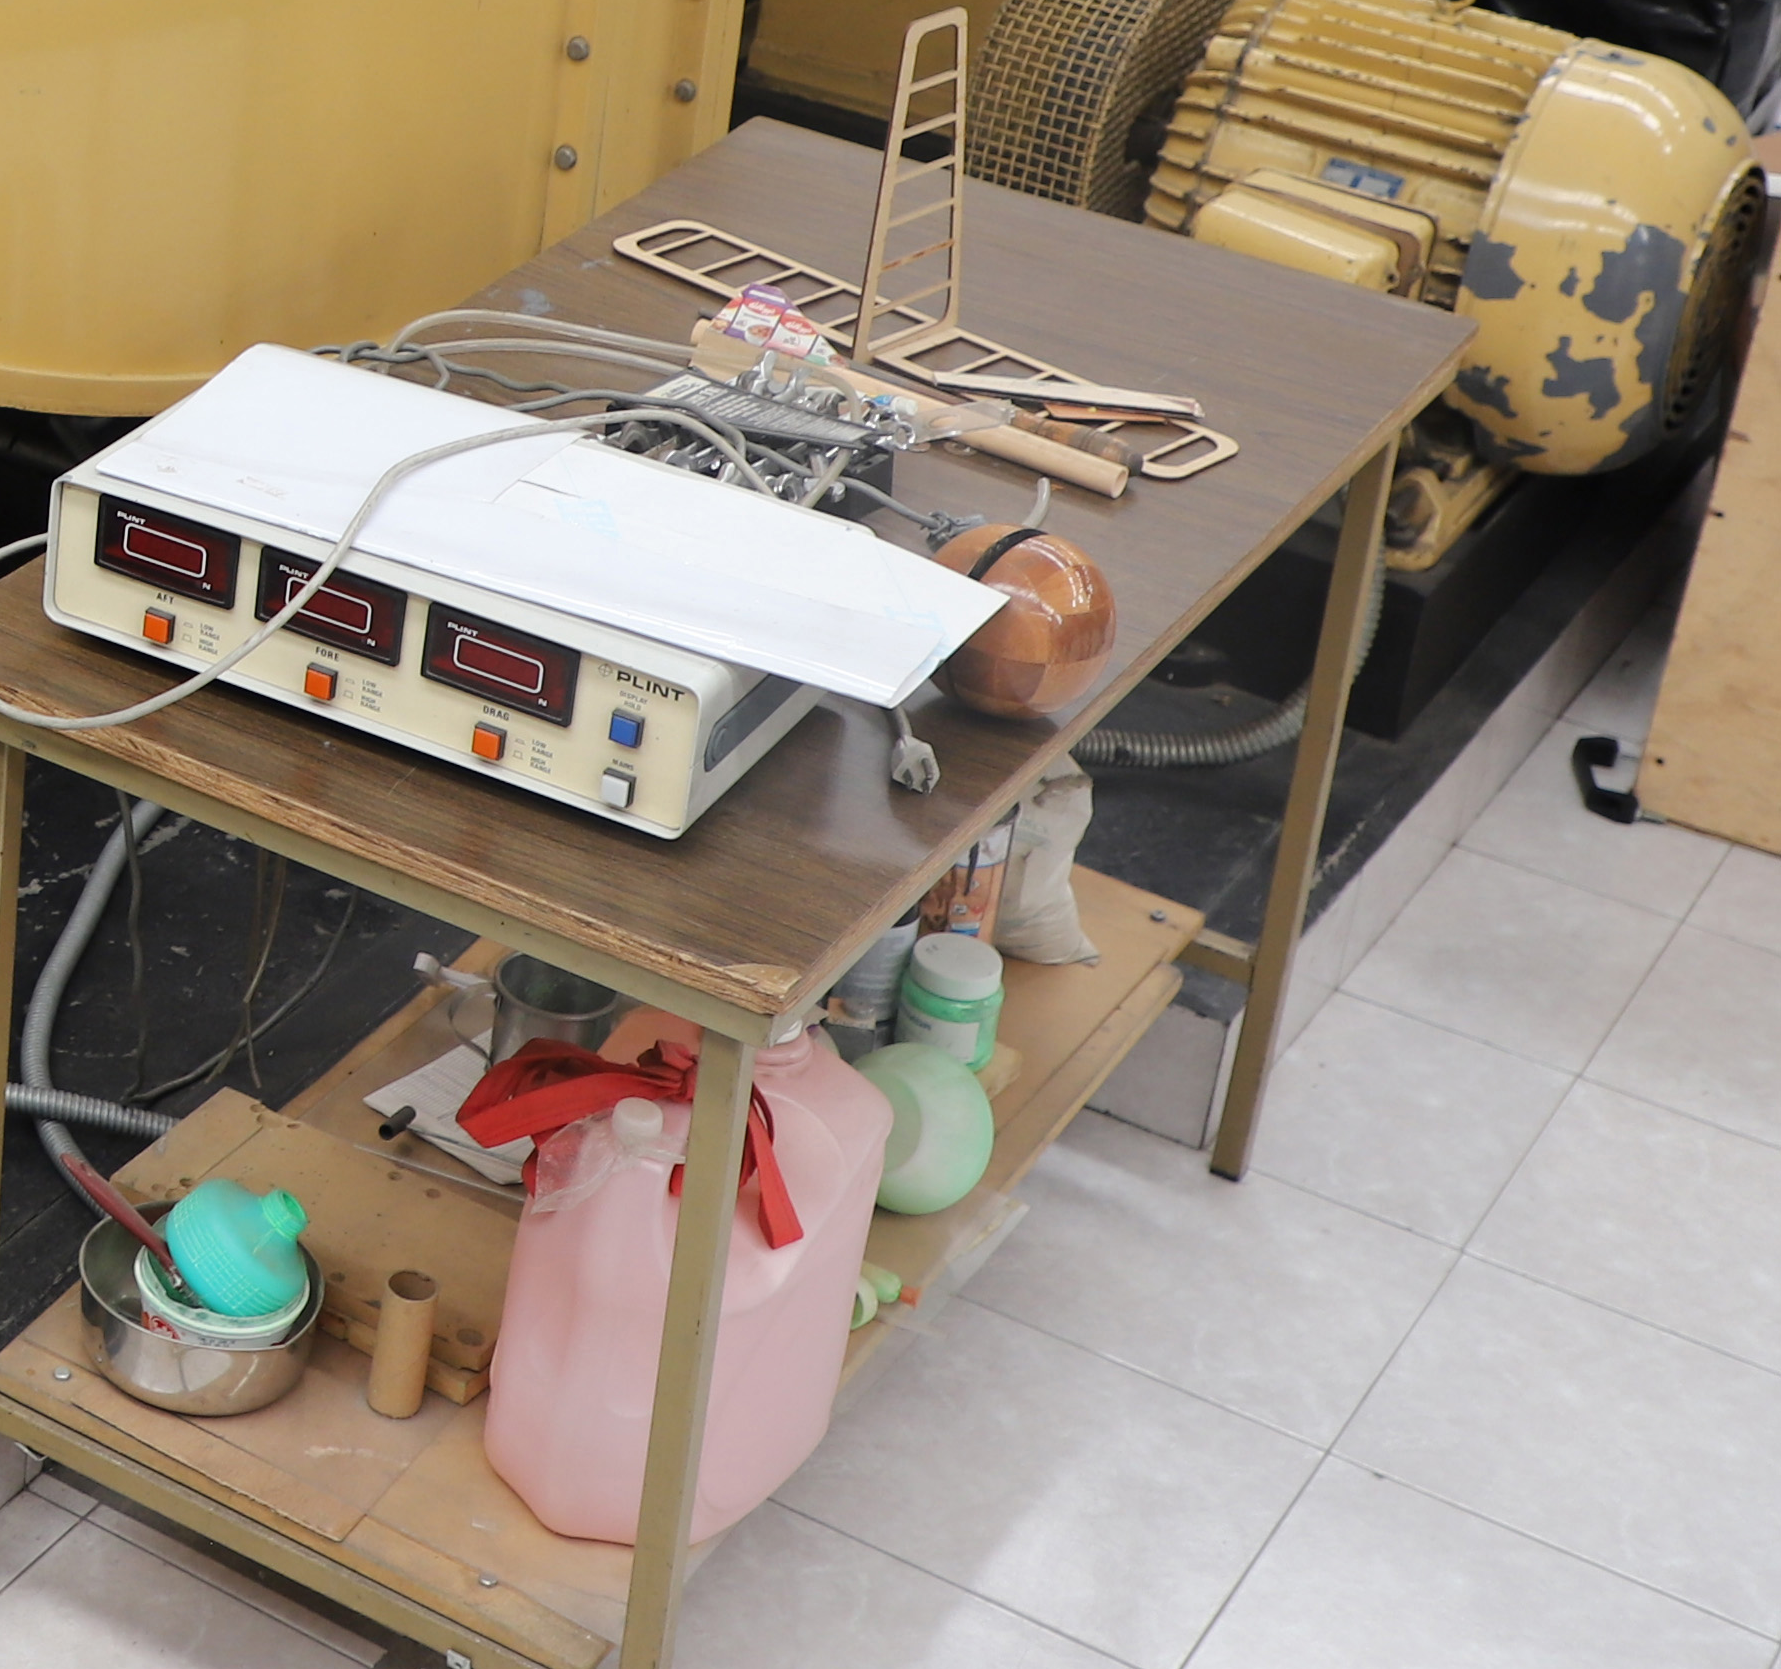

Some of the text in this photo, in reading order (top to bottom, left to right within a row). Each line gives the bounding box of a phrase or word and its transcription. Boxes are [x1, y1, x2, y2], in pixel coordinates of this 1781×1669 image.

[117, 510, 146, 525] PLINT
[279, 564, 309, 579] PLINT
[202, 581, 212, 591] N
[156, 592, 175, 605] AFT
[448, 621, 479, 637] PLINT
[366, 637, 377, 647] N
[315, 646, 339, 661] FORE
[616, 670, 685, 702] PLINT
[538, 698, 548, 707] N
[483, 705, 510, 721] DRAG
